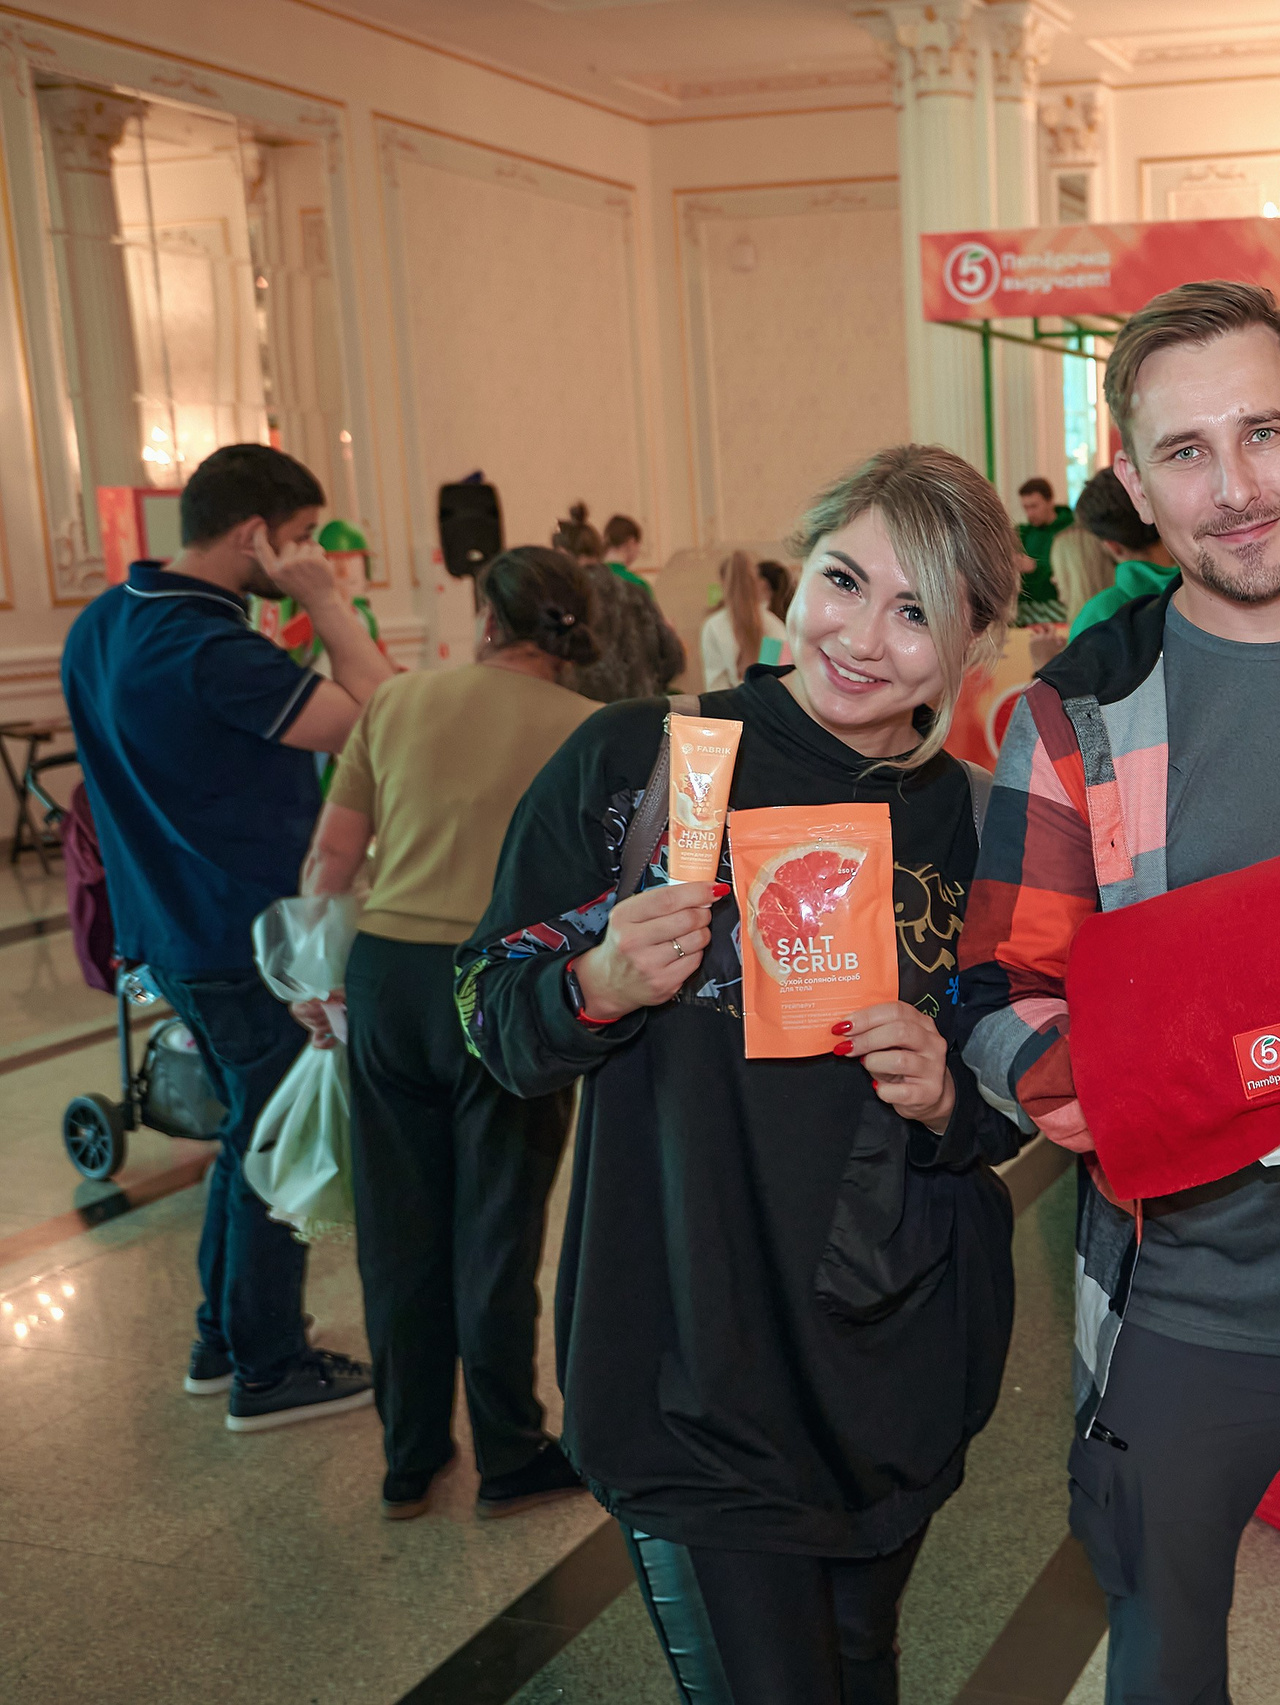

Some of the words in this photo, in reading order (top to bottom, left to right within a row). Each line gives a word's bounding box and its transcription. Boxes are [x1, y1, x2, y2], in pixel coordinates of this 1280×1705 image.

[697, 745, 731, 755] FABRIK
[682, 829, 716, 841] HAND
[678, 838, 718, 850] CREAM
[777, 935, 834, 956] SALT
[778, 952, 859, 975] SCRUB
[780, 976, 803, 987] сухой
[804, 974, 837, 984] соляной
[838, 972, 861, 983] скраб
